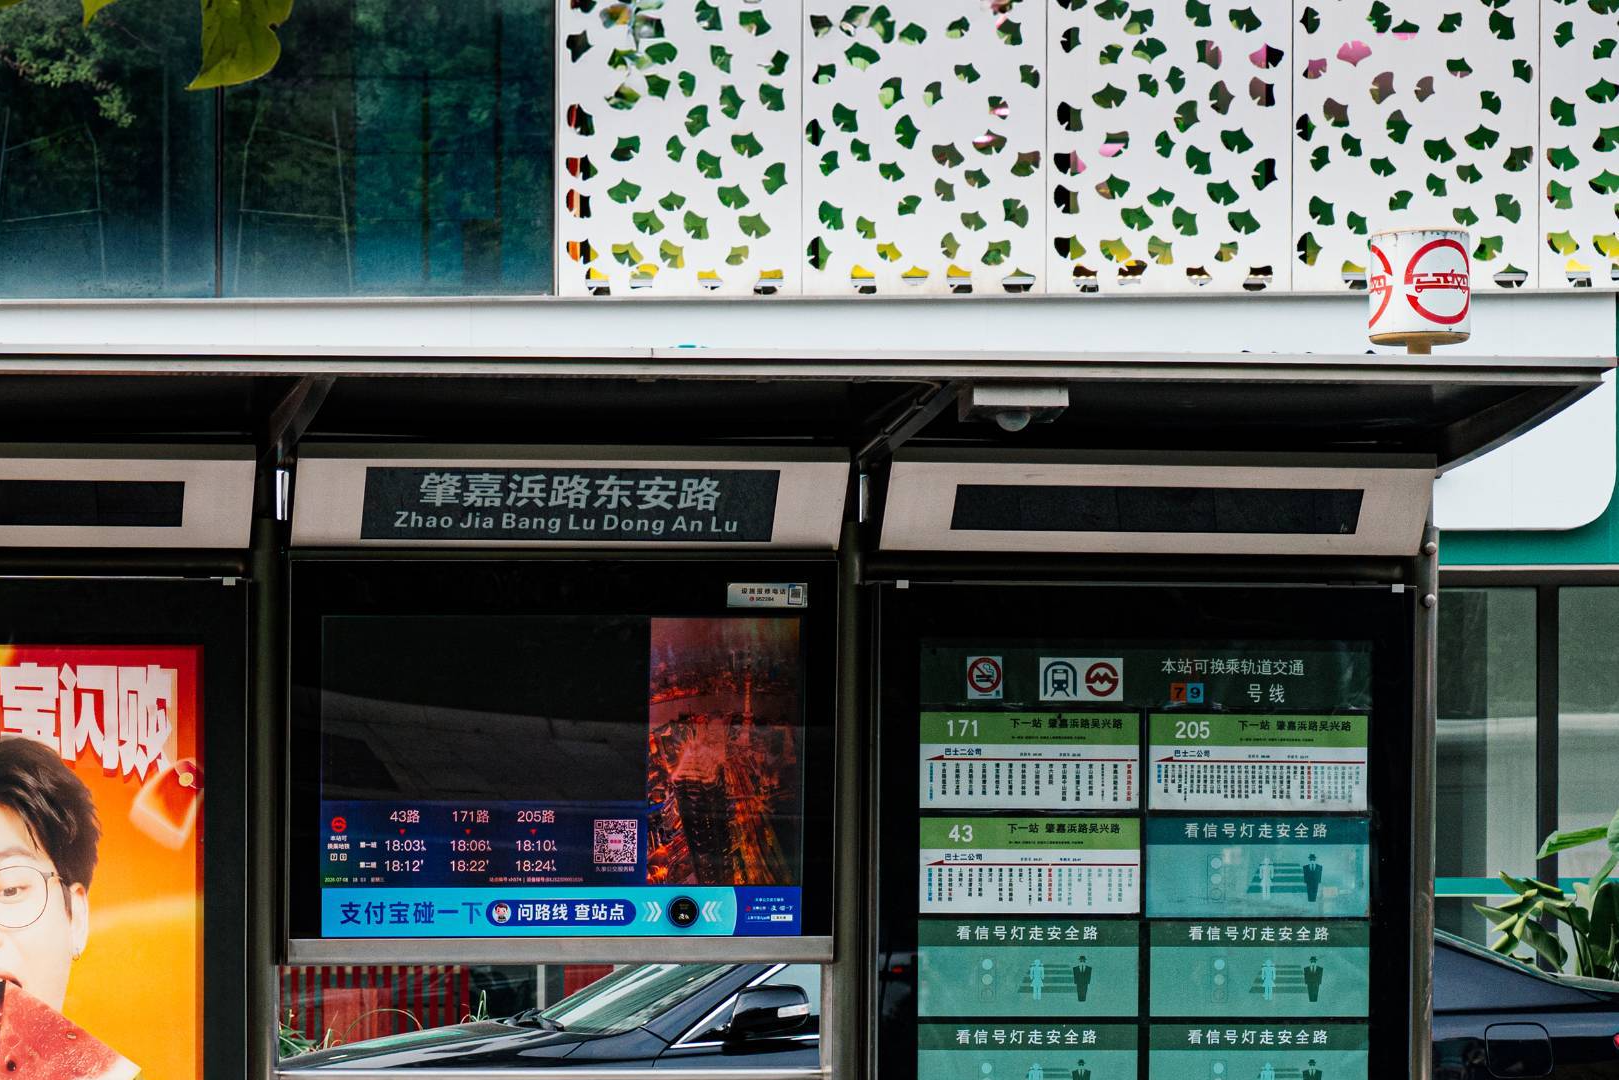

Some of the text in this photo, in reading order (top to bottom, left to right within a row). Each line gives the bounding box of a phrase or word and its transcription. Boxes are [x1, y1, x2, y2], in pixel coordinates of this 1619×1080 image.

[420, 472, 721, 511] 肇嘉浜路东安路
[394, 511, 738, 534] Zhao Jia Bang Lu Dong An Lu
[1161, 659, 1305, 676] 本站可换乘轨道交通
[1174, 684, 1285, 703] 7 9 号线
[947, 720, 978, 737] 171
[1010, 717, 1123, 729] 下一站 肇嘉浜路吴兴路
[1175, 721, 1210, 738] 205
[1238, 720, 1352, 731] 下一站 肇嘉浜路吴兴路
[945, 748, 982, 756] 巴士二公司
[1174, 750, 1211, 758] 巴士二公司
[390, 810, 556, 823] 43路 171路 205路
[948, 825, 973, 842] 43
[1008, 823, 1121, 834] 下一站 肇嘉浜路吴兴路
[1184, 822, 1328, 839] 看信号灯走安全路
[945, 853, 983, 861] 巴士二公司
[339, 901, 625, 925] 支付宝碰一下 问路线 查站点
[956, 925, 1098, 941] 看信号灯走安全路
[1188, 925, 1329, 941] 看信号灯走安全路
[956, 1029, 1097, 1045] 看信号灯走安全路
[1187, 1029, 1328, 1045] 看信号灯走安全路
